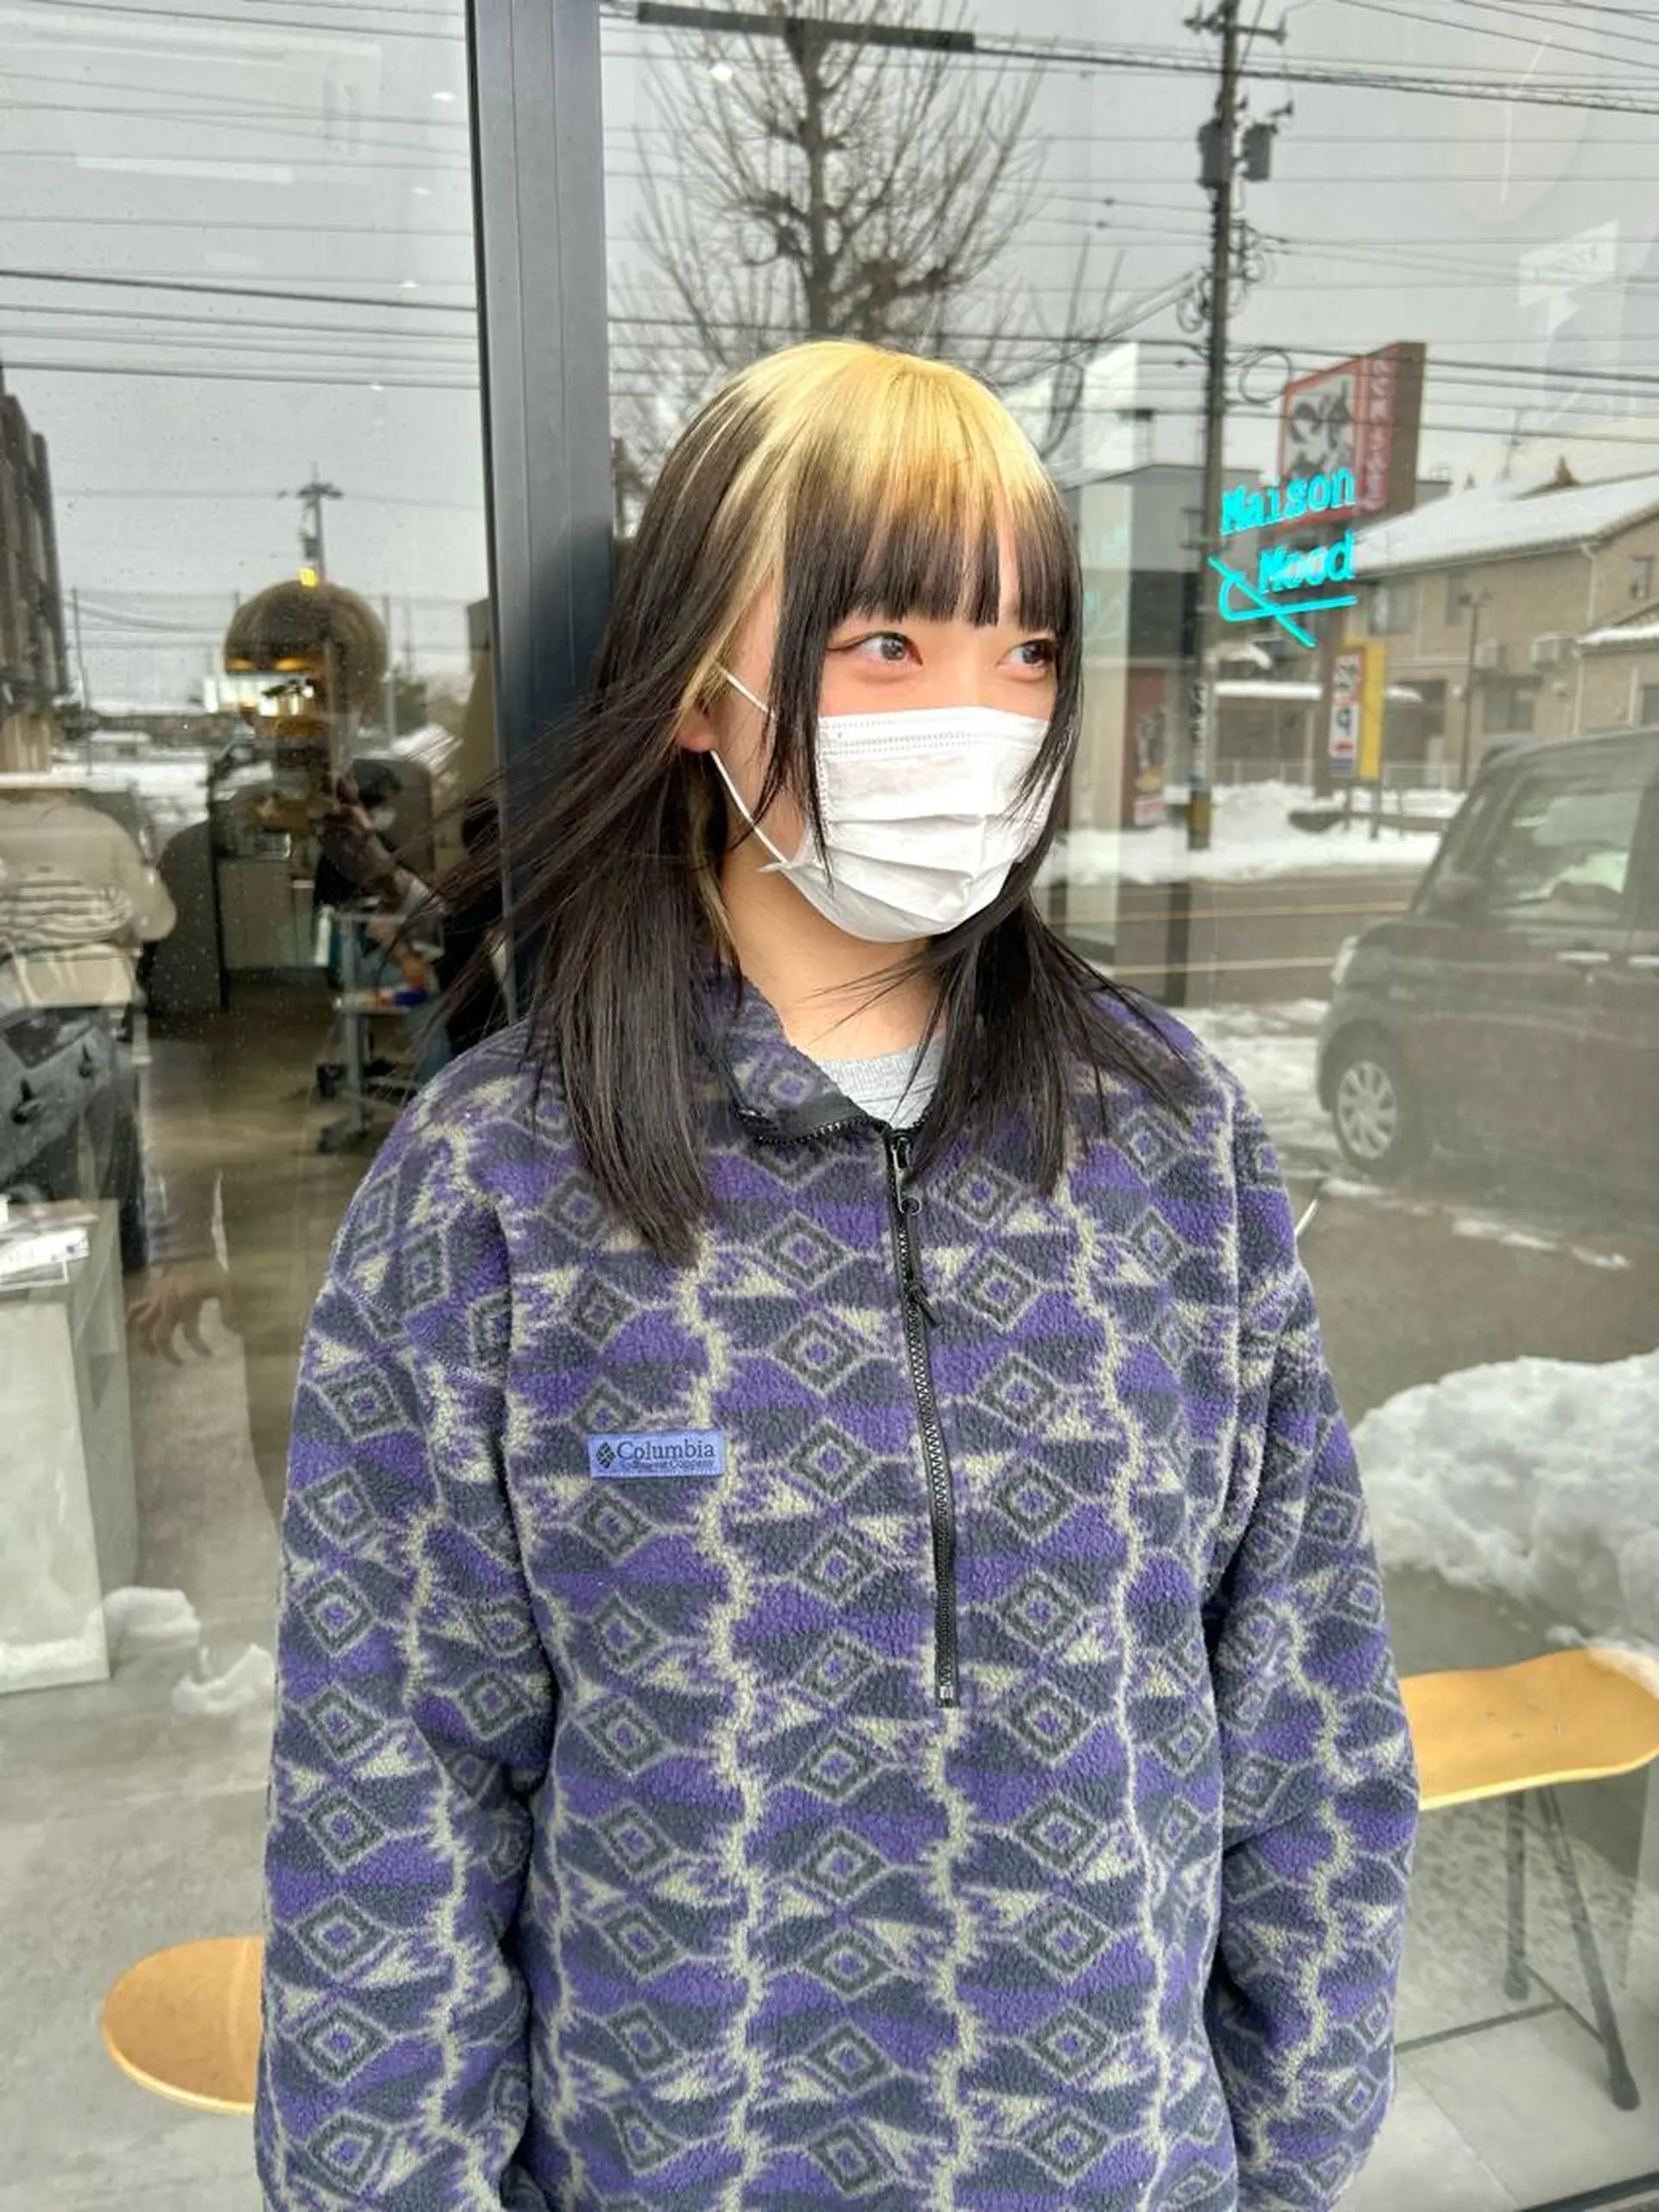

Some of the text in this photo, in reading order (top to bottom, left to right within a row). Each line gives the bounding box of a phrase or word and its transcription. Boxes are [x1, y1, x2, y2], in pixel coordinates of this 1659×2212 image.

[1219, 466, 1356, 536] Maison
[1258, 528, 1356, 594] Mood
[616, 1438, 715, 1460] Columbia
